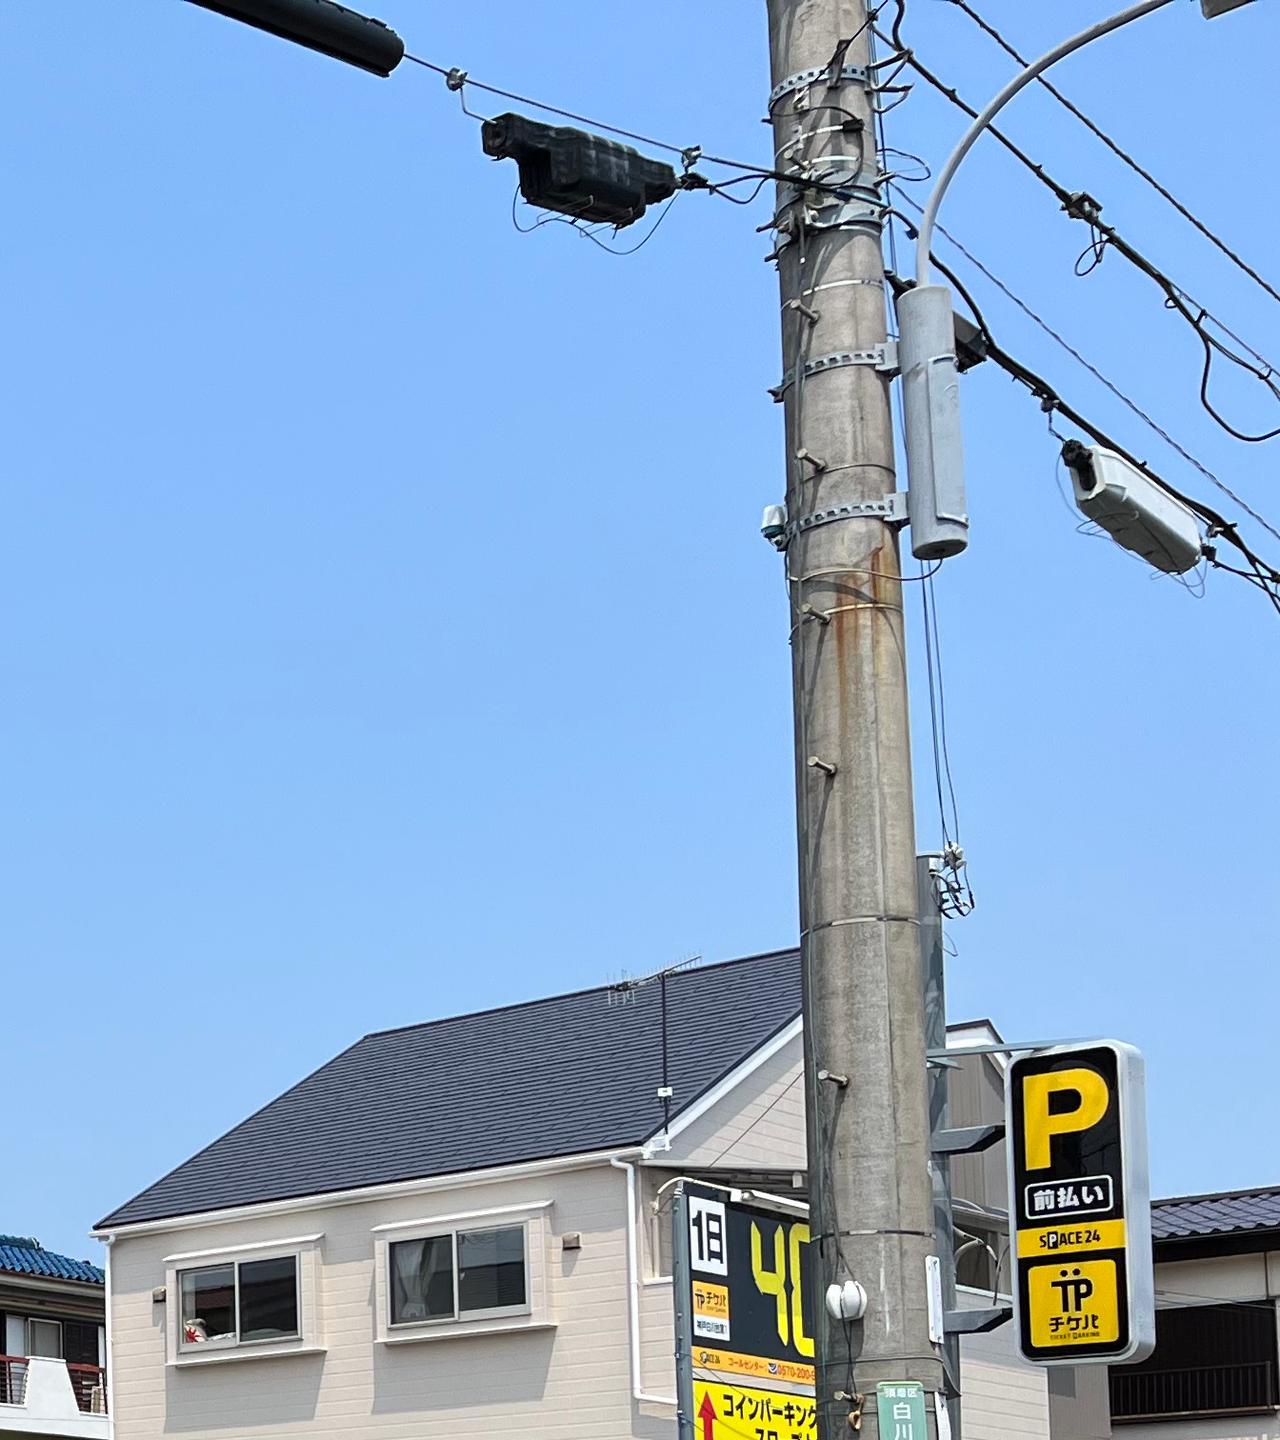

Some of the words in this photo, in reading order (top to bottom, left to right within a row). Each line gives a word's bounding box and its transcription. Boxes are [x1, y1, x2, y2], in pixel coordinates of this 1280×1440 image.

[1022, 1068, 1109, 1171] P
[1033, 1185, 1104, 1211] 前払い
[691, 1210, 724, 1265] 1日
[1049, 1314, 1099, 1332] チケパ
